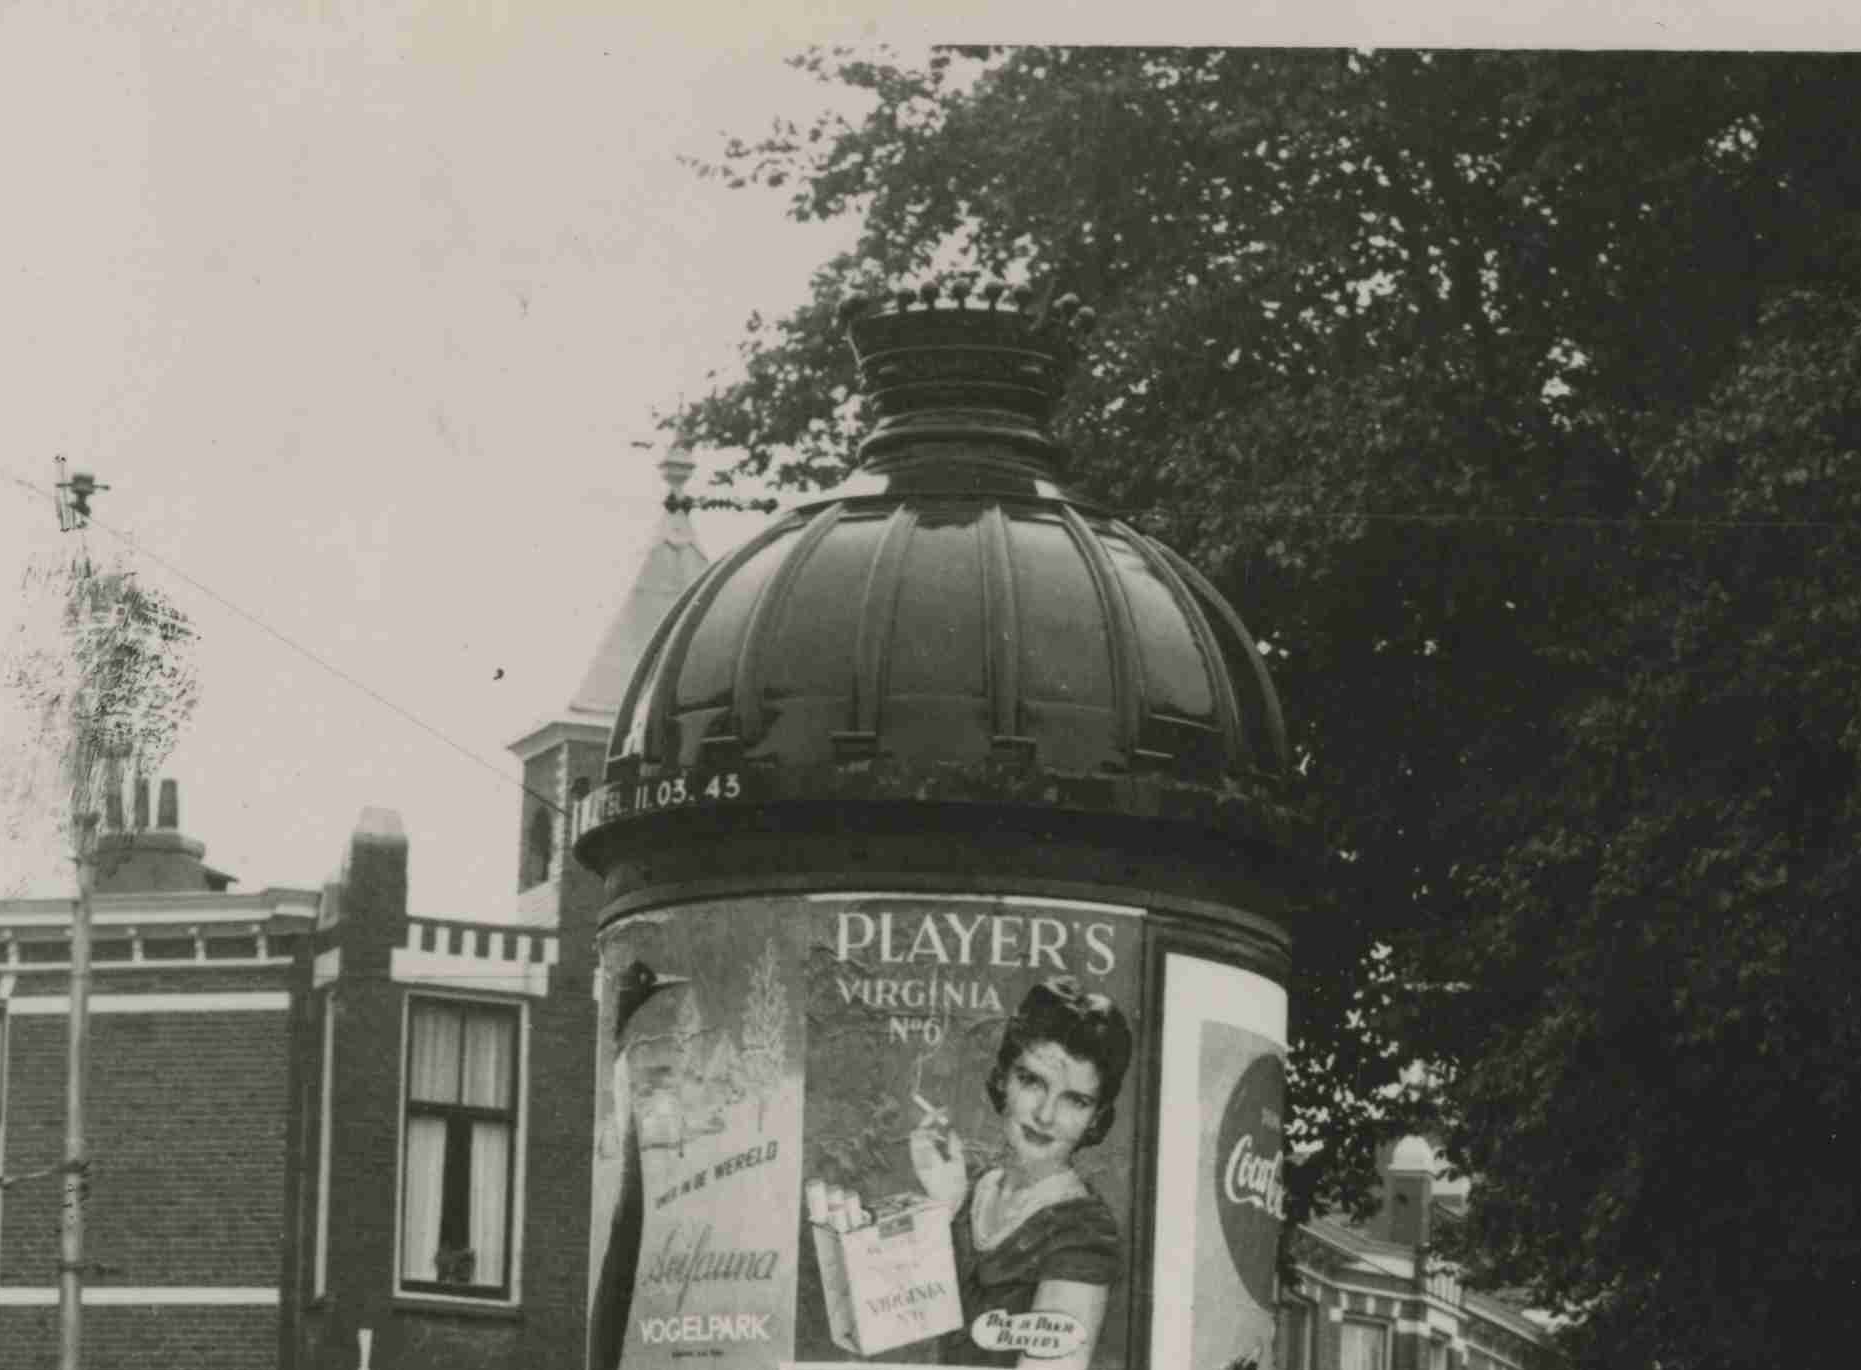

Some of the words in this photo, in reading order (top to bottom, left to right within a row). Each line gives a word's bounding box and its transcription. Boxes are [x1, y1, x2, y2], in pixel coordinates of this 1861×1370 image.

[837, 912, 1116, 975] PLAYER'S
[836, 977, 1003, 1013] VIRGINIA
[714, 1140, 779, 1180] WERELD
[639, 1310, 773, 1344] VOGELPARK
